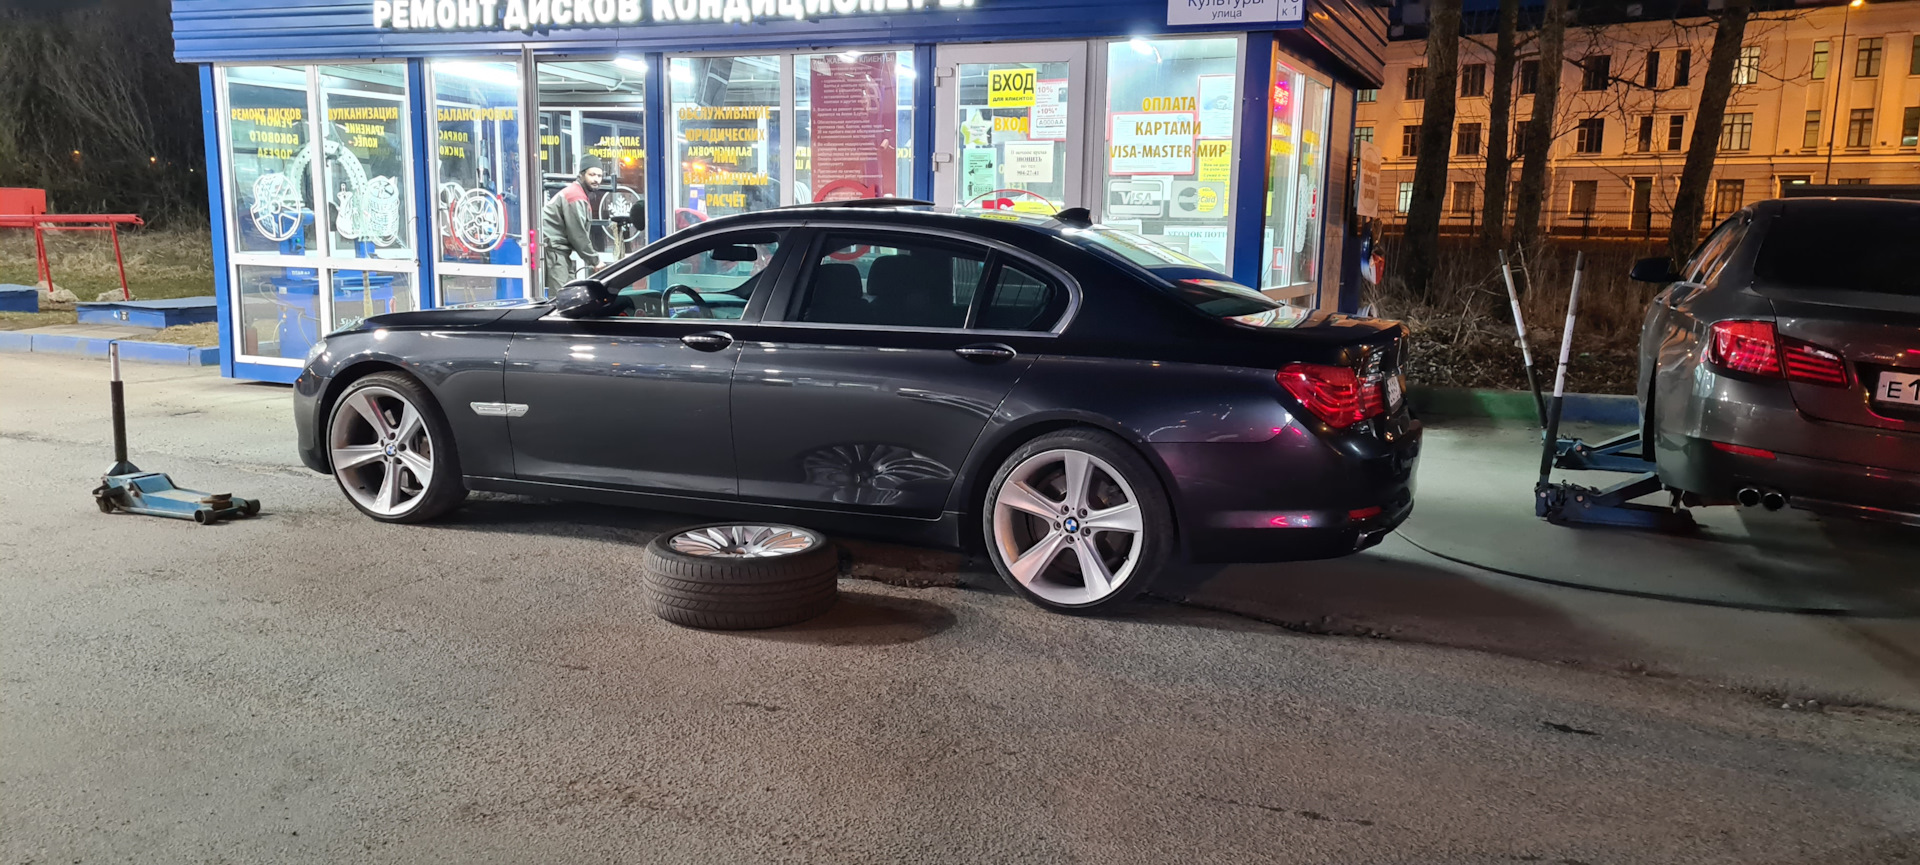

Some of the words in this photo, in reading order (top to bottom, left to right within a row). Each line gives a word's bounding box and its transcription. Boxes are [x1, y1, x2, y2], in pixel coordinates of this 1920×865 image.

[373, 0, 496, 28] РЕМОНТ
[504, 0, 641, 30] ДИСКОВ
[651, 0, 976, 23] КОНДИЦИ
[1212, 9, 1242, 20] улица
[1292, 6, 1297, 15] 1
[992, 73, 1034, 94] ВХОД
[1142, 97, 1196, 112] ОПЛАТА
[231, 108, 266, 120] РЕМОНТ
[267, 108, 302, 120] ДИСКОВ
[328, 107, 398, 122] ВУЛКАНИЗАЦИЯ
[437, 107, 514, 121] БАЛАНСИРОВКА
[679, 106, 771, 120] ОБСЛУЖИВАНИЕ
[994, 116, 1029, 134] ВХОД
[1135, 121, 1201, 135] КАРТАМИ
[685, 127, 765, 144] ЮРИДИЧЕСКИХ
[713, 151, 738, 166] ЛИЦ
[683, 171, 768, 186] БЕЗНАЛИЧНЫЙ
[706, 191, 746, 208] РАСЧЁТ
[1118, 191, 1153, 205] VISA
